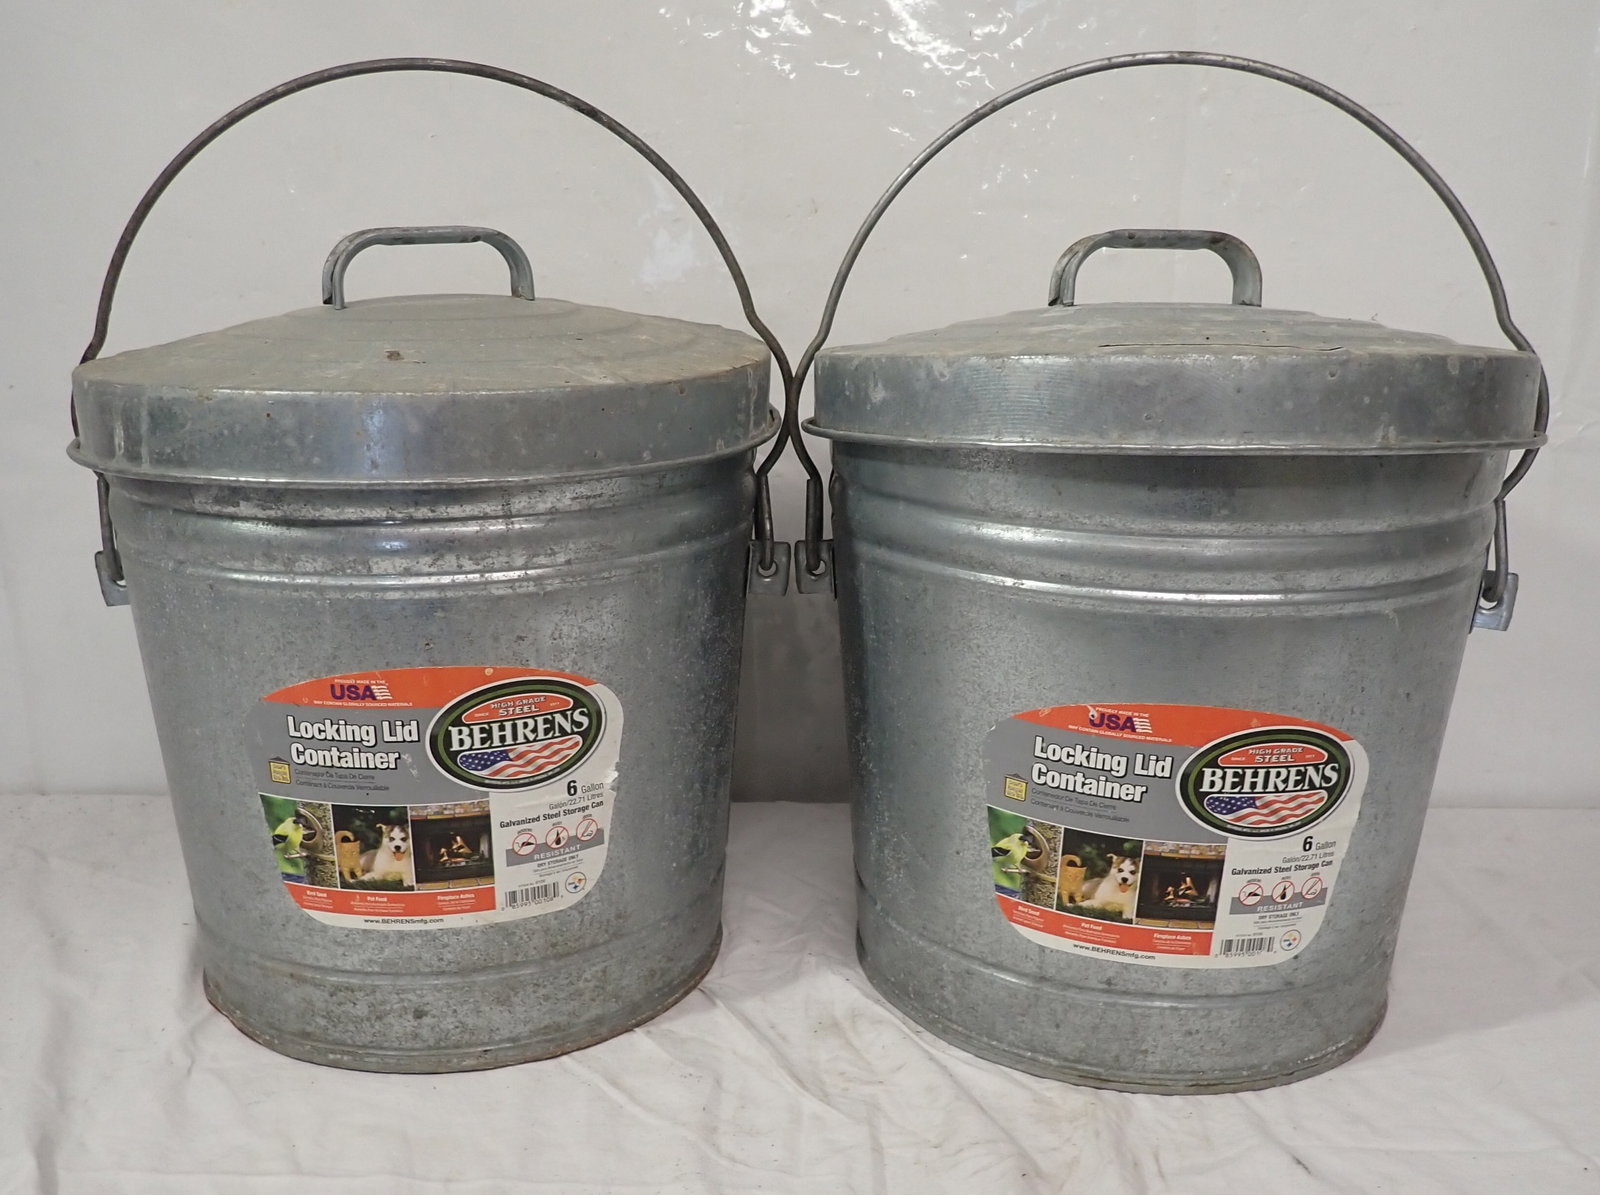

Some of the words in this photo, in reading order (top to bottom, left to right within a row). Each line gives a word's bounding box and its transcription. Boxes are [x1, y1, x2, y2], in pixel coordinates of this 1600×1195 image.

[330, 684, 377, 701] USA
[491, 701, 514, 709] HIGH
[516, 696, 547, 705] GRADE
[499, 705, 540, 716] STEEL
[287, 715, 377, 747] Locking
[382, 720, 420, 742] Lid
[448, 707, 589, 751] BEHRENS
[1089, 713, 1136, 732] USA
[290, 743, 400, 769] Container
[1033, 735, 1128, 778] Locking
[1134, 753, 1173, 778] Lid
[1255, 754, 1295, 763] STEEL
[1031, 762, 1148, 803] Container
[1199, 763, 1339, 793] BEHRENS
[567, 780, 578, 796] 6
[581, 782, 604, 794] Gallon
[587, 793, 603, 801] Litres
[500, 815, 541, 828] Galvanized
[542, 811, 561, 821] Steel
[563, 805, 590, 818] Storage
[591, 800, 604, 809] Can
[534, 844, 581, 860] RESISTANT
[1303, 836, 1313, 852] 6
[1315, 841, 1337, 851] Gallon
[1231, 867, 1272, 875] Galvanized
[1274, 865, 1292, 873] Steel
[1293, 862, 1319, 872] Storage
[1257, 902, 1303, 912] RESISTANT
[1073, 943, 1155, 960] www.BEHRENSmfg.com
